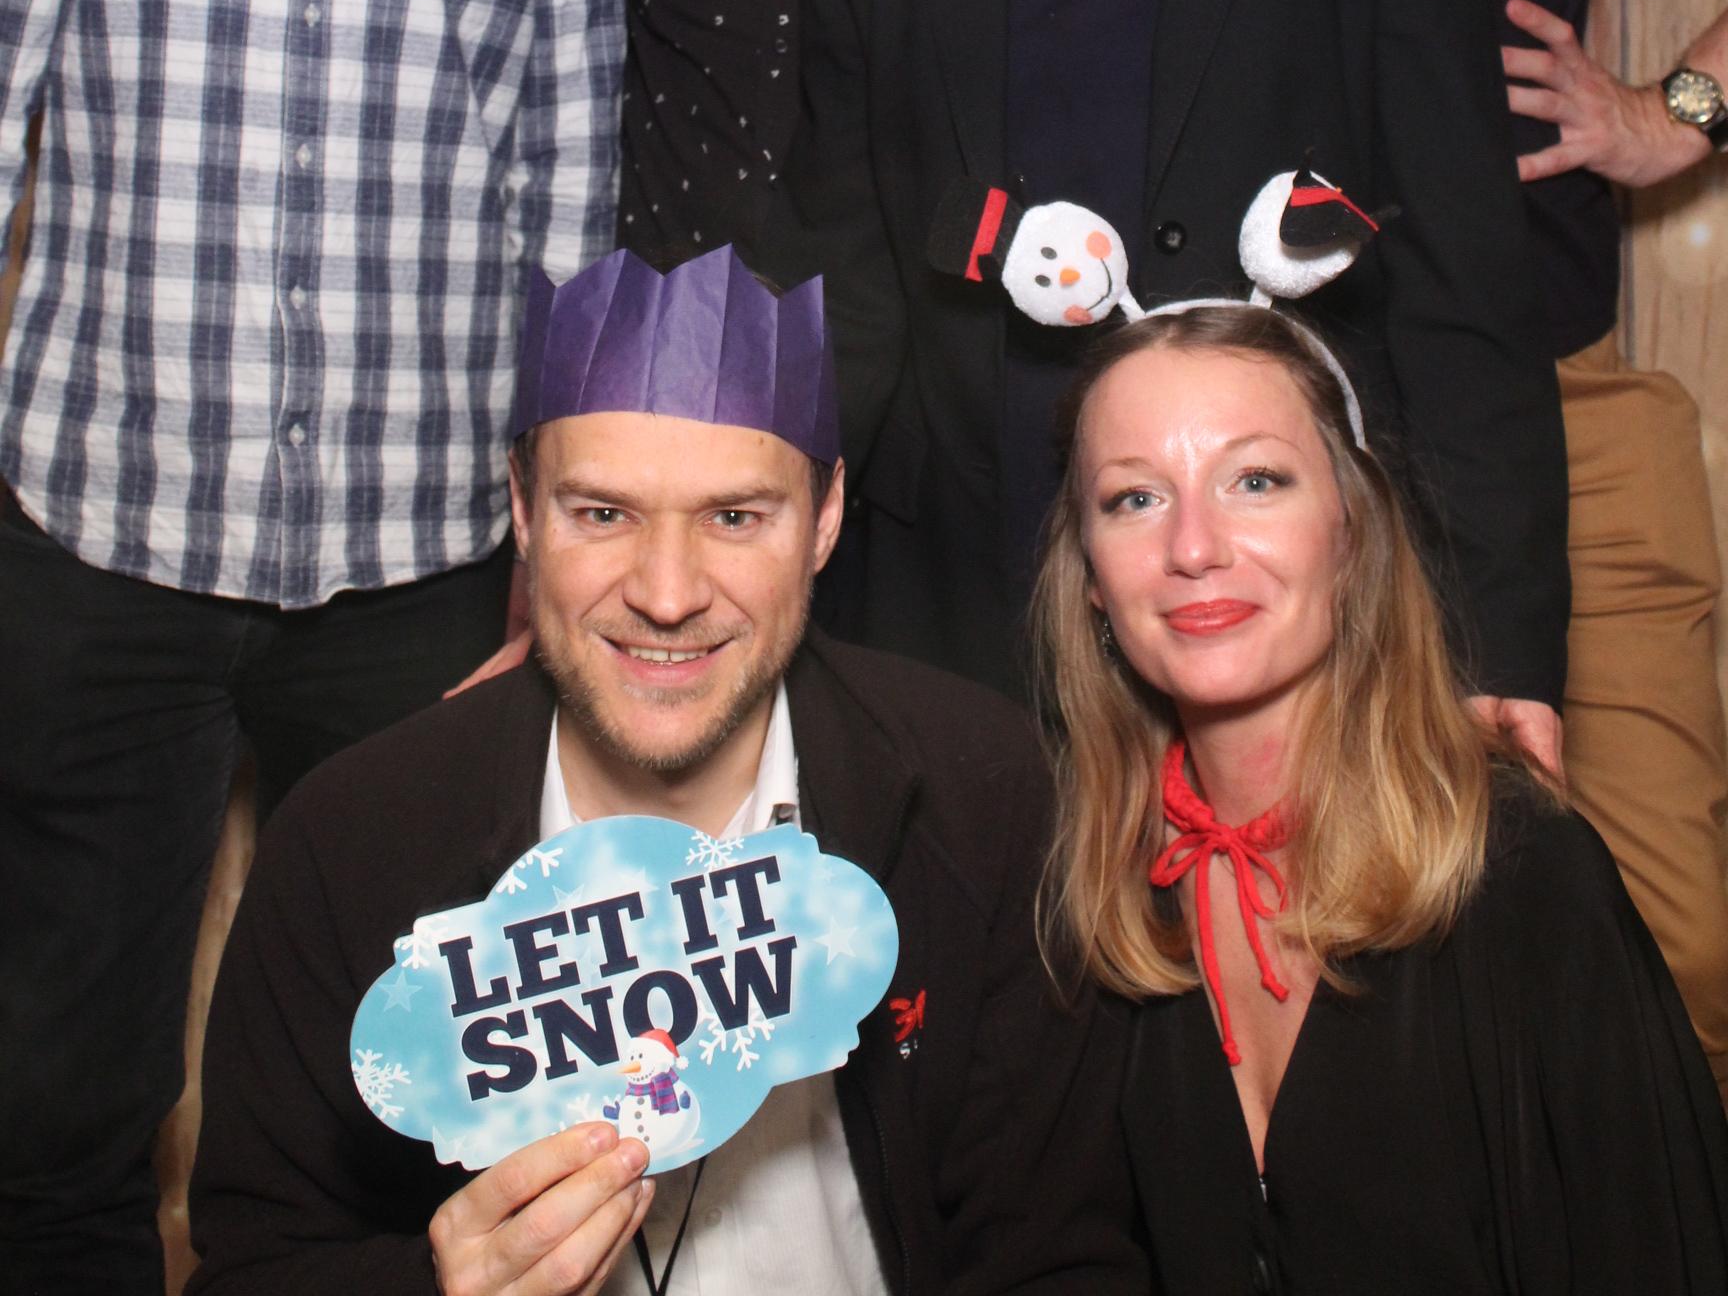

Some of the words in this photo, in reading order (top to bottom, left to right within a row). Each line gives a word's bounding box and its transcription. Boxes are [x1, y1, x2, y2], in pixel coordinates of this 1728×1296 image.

[439, 891, 644, 1017] LET
[670, 855, 781, 955] IT
[460, 935, 798, 1101] SNOW
